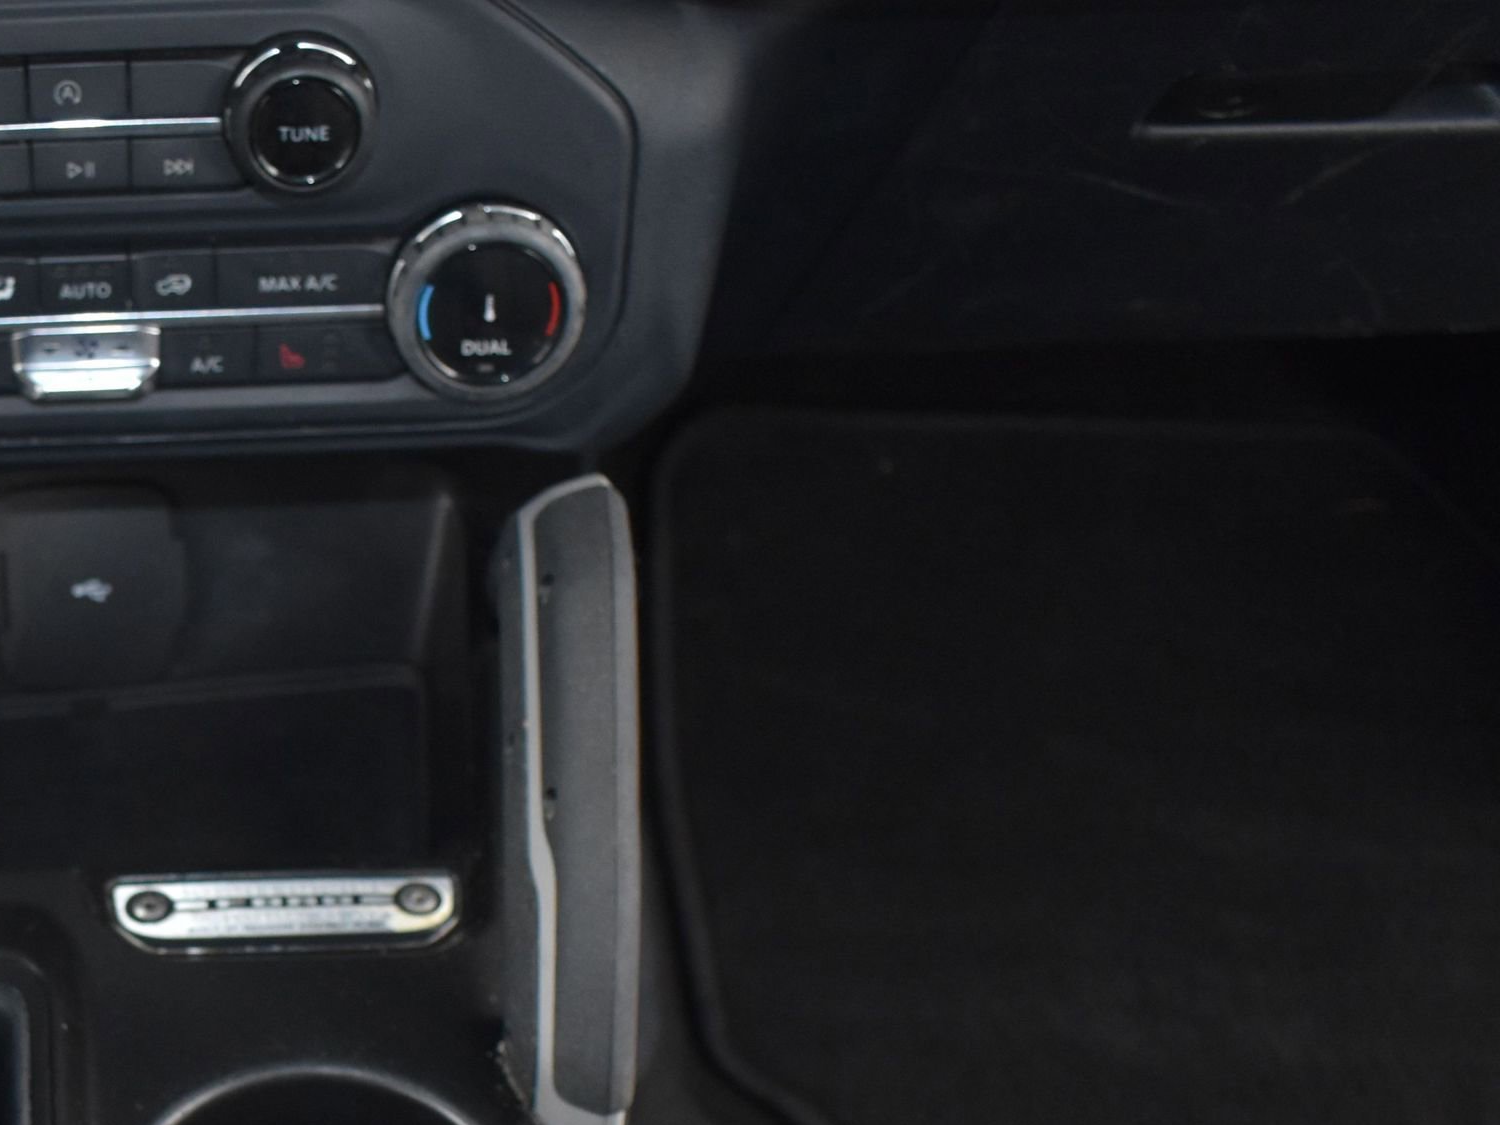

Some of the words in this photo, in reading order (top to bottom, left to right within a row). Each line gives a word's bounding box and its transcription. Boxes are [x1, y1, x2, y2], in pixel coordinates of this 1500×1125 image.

[278, 125, 330, 142] TUNE
[59, 281, 113, 299] AUTO
[258, 275, 302, 292] MAX
[304, 272, 339, 292] A/C
[460, 339, 512, 357] DUAL
[190, 355, 224, 374] A/C
